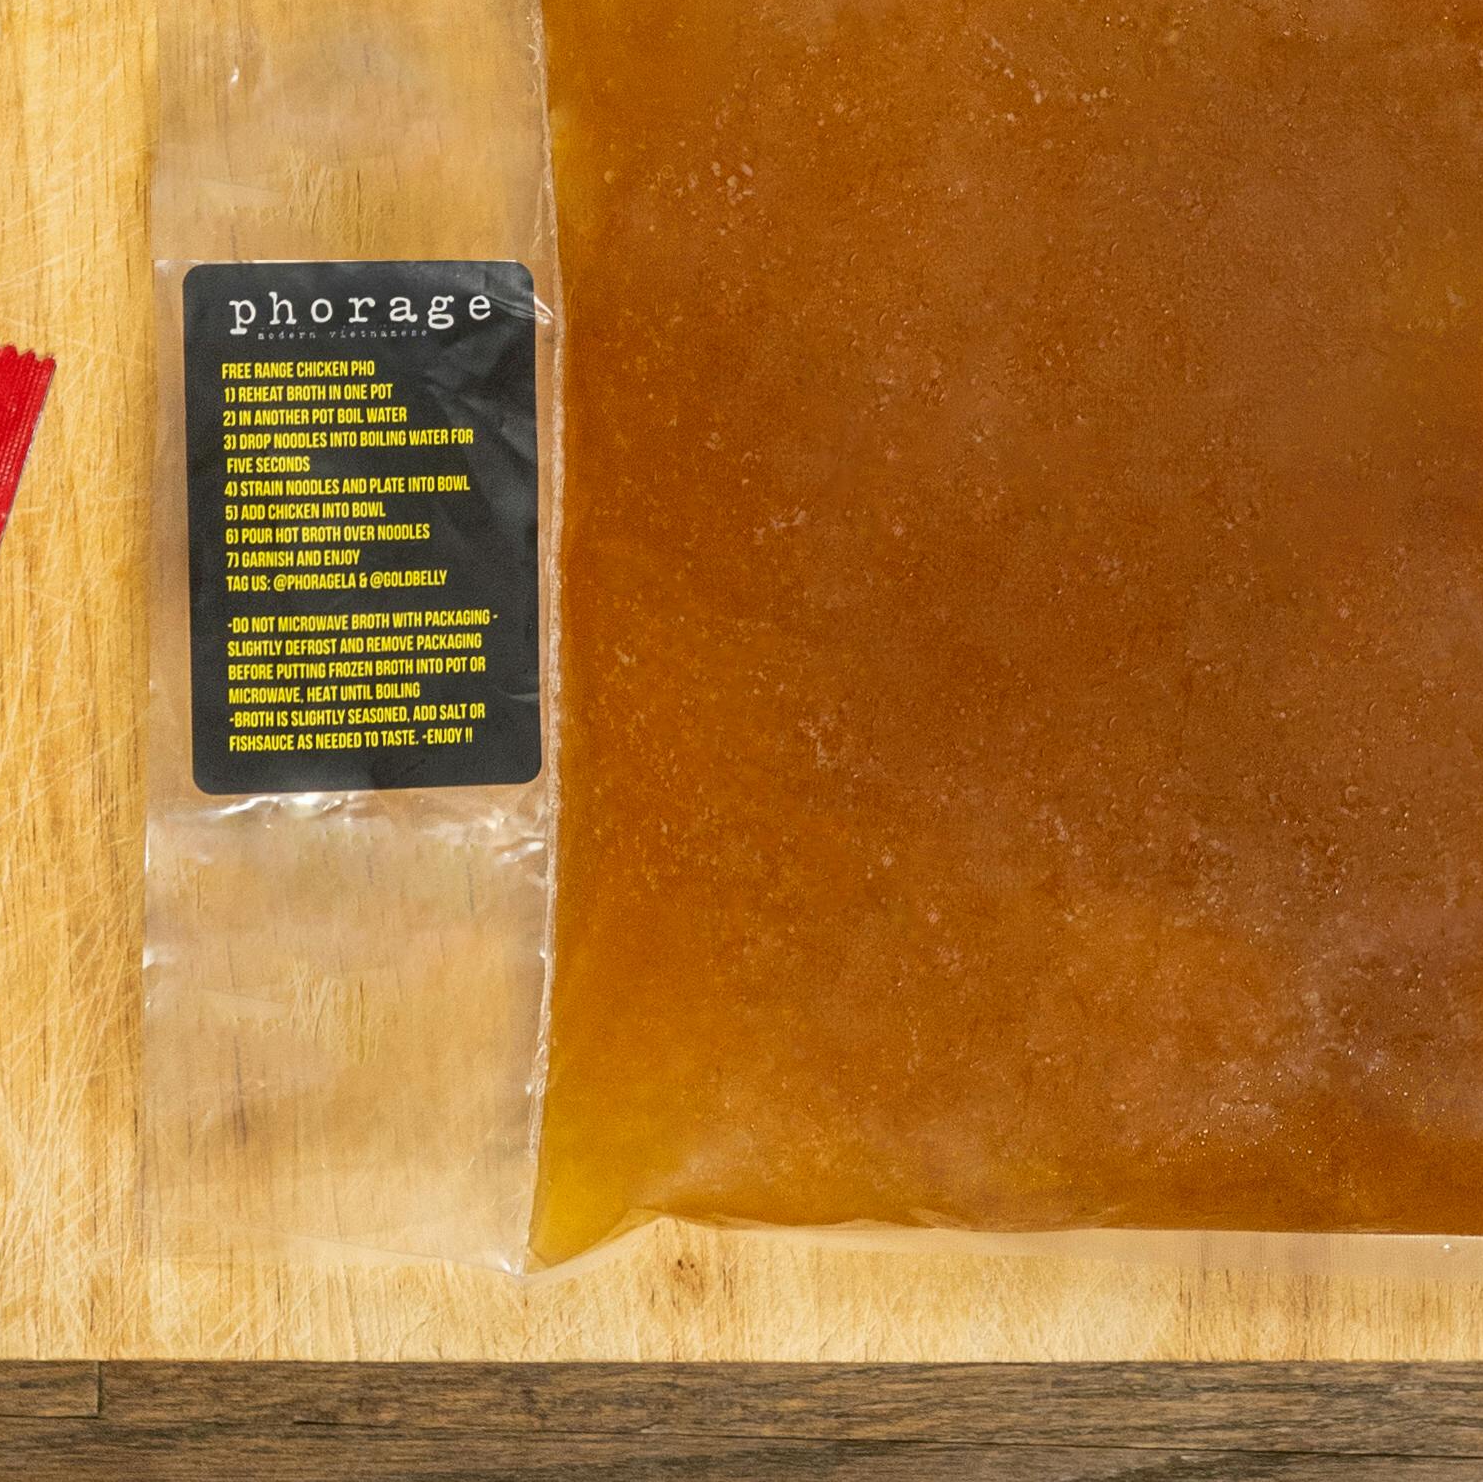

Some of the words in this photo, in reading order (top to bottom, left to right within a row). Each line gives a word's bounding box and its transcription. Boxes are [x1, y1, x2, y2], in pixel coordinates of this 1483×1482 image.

[228, 291, 492, 335] phorage
[222, 362, 250, 379] FREE
[254, 362, 293, 378] RANGE
[296, 361, 348, 377] CHICKEN
[350, 360, 374, 376] PHO
[238, 386, 283, 402] REHEAT
[286, 385, 326, 401] BROTH
[328, 385, 342, 399] IN
[344, 384, 366, 400] ONE
[370, 383, 392, 399] POT
[239, 411, 252, 425] IN
[254, 409, 310, 425] ANOTHER
[311, 408, 334, 424] POT
[337, 408, 362, 424] BOIL
[366, 406, 407, 423] WATER
[239, 433, 272, 450] DROP
[273, 432, 327, 448] NOODLES
[330, 431, 357, 447] INTO
[360, 430, 406, 447] BOILING
[409, 429, 449, 445] WATER
[450, 428, 473, 443] FOR
[226, 457, 252, 473] FIVE
[255, 456, 310, 473] SECONDS
[240, 480, 284, 496] STRAIN
[285, 479, 340, 495] NOODLES
[342, 478, 367, 494] AND
[369, 476, 404, 493] PLATE
[408, 476, 435, 492] INTO
[437, 475, 469, 491] BOWL
[241, 504, 266, 521] ADD
[267, 503, 320, 520] CHICKEN
[322, 502, 350, 518] INTO
[352, 501, 385, 518] BOWL
[241, 527, 273, 544] POUR
[275, 527, 298, 543] HOT
[301, 526, 341, 543] BROTH
[344, 525, 375, 541] OVER
[377, 523, 430, 540] NOODLES
[242, 550, 294, 568] GARNISH
[296, 550, 322, 566] AND
[323, 549, 360, 566] ENJOY
[226, 575, 249, 591] TAG
[273, 572, 356, 592] @PHORAGELA
[370, 570, 446, 588] @GOLDBELLY
[252, 616, 274, 633] NOT
[278, 614, 348, 632] MICROWAVE
[352, 613, 388, 630] BROTH
[394, 612, 422, 628] WITH
[425, 609, 490, 627] PACKAGING
[227, 640, 282, 657] SLIGHTLY
[285, 638, 336, 656] DEFROST
[340, 637, 364, 653] AND
[366, 635, 413, 652] REMOVE
[416, 633, 482, 650] PACKAGING
[228, 663, 273, 680] BEFORE
[276, 663, 326, 680] PUTTING
[328, 661, 374, 677] FROZEN
[375, 659, 414, 675] BROTH
[416, 658, 443, 674] INTO
[445, 656, 466, 672] POT
[469, 656, 486, 671] OR
[306, 685, 337, 702] HEAT
[340, 684, 372, 701] UNTIL
[375, 682, 420, 699] BOILING
[276, 710, 288, 727] IS
[290, 709, 345, 726] SLIGHTLY
[413, 705, 437, 721] ADD
[439, 703, 466, 720] SALT
[469, 703, 485, 719] OR
[229, 734, 294, 751] FISHSAUCE
[297, 733, 313, 749] AS
[315, 732, 362, 749] NEEDED
[364, 731, 379, 747] TO
